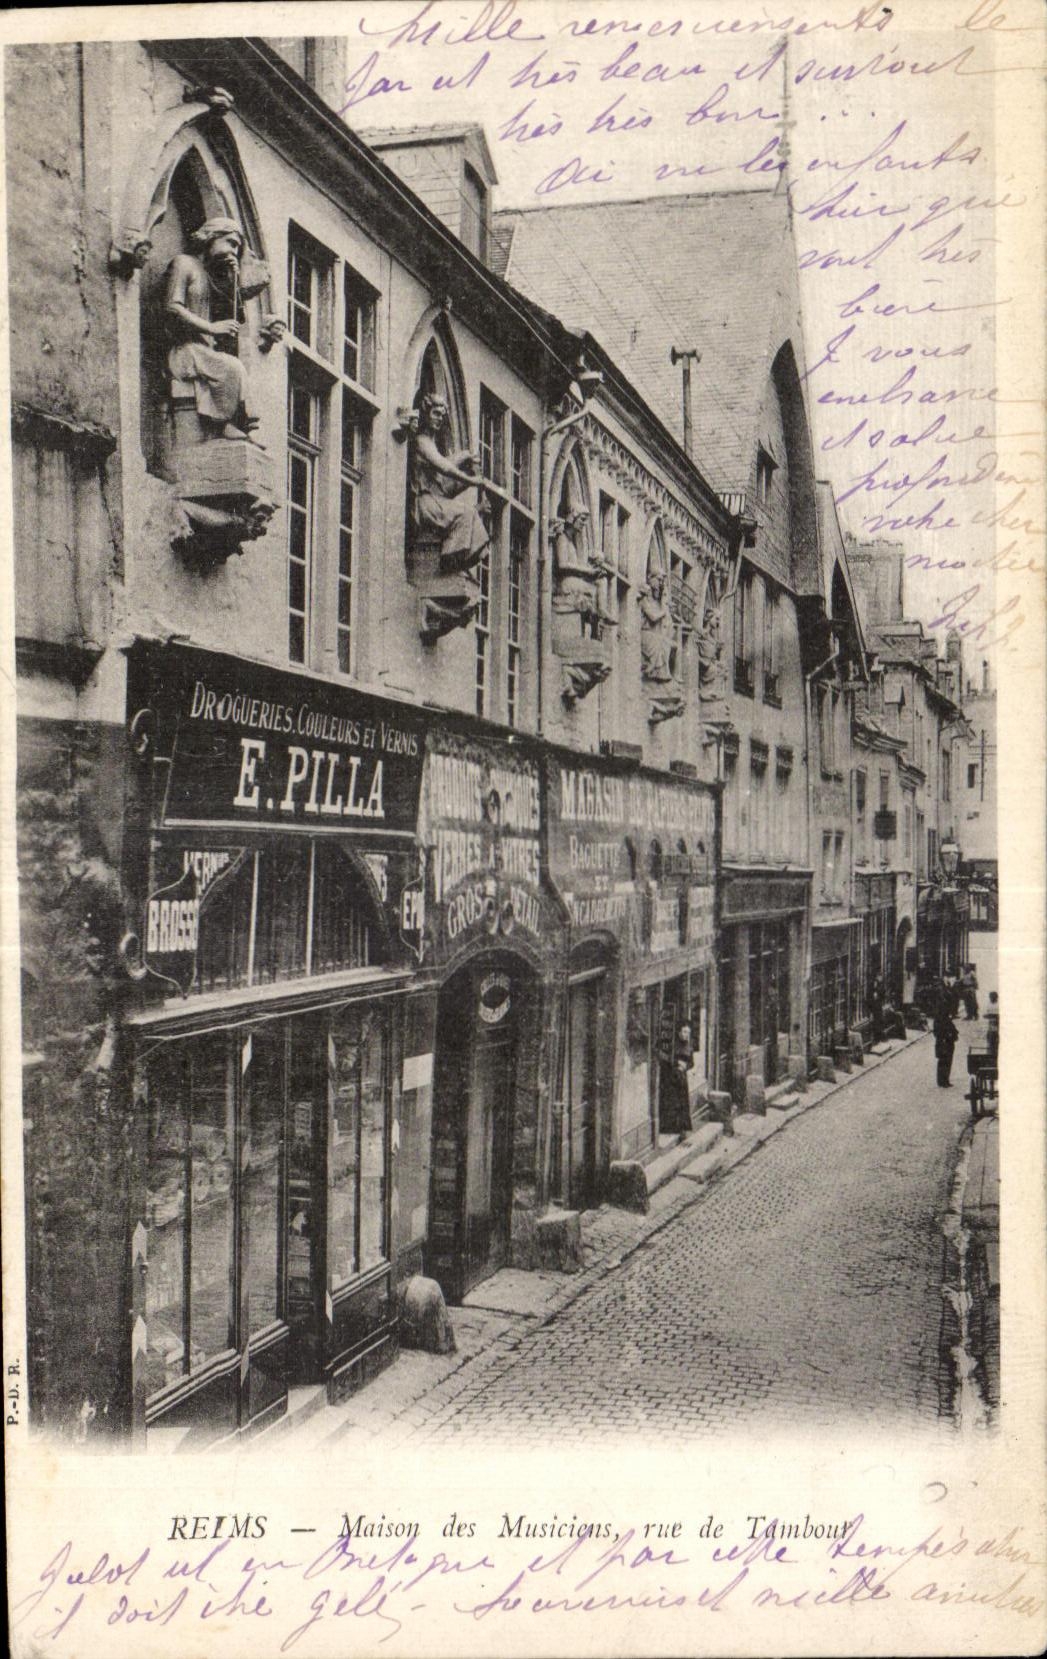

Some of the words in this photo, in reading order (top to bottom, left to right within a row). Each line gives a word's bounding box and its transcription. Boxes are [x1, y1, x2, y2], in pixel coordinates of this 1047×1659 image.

[600, 42, 705, 82] beau
[735, 42, 788, 81] et
[296, 703, 360, 746] COULEURS
[362, 729, 377, 749] ET
[380, 721, 418, 757] VERNIS
[280, 745, 385, 819] PILLA
[448, 881, 481, 939] GROS
